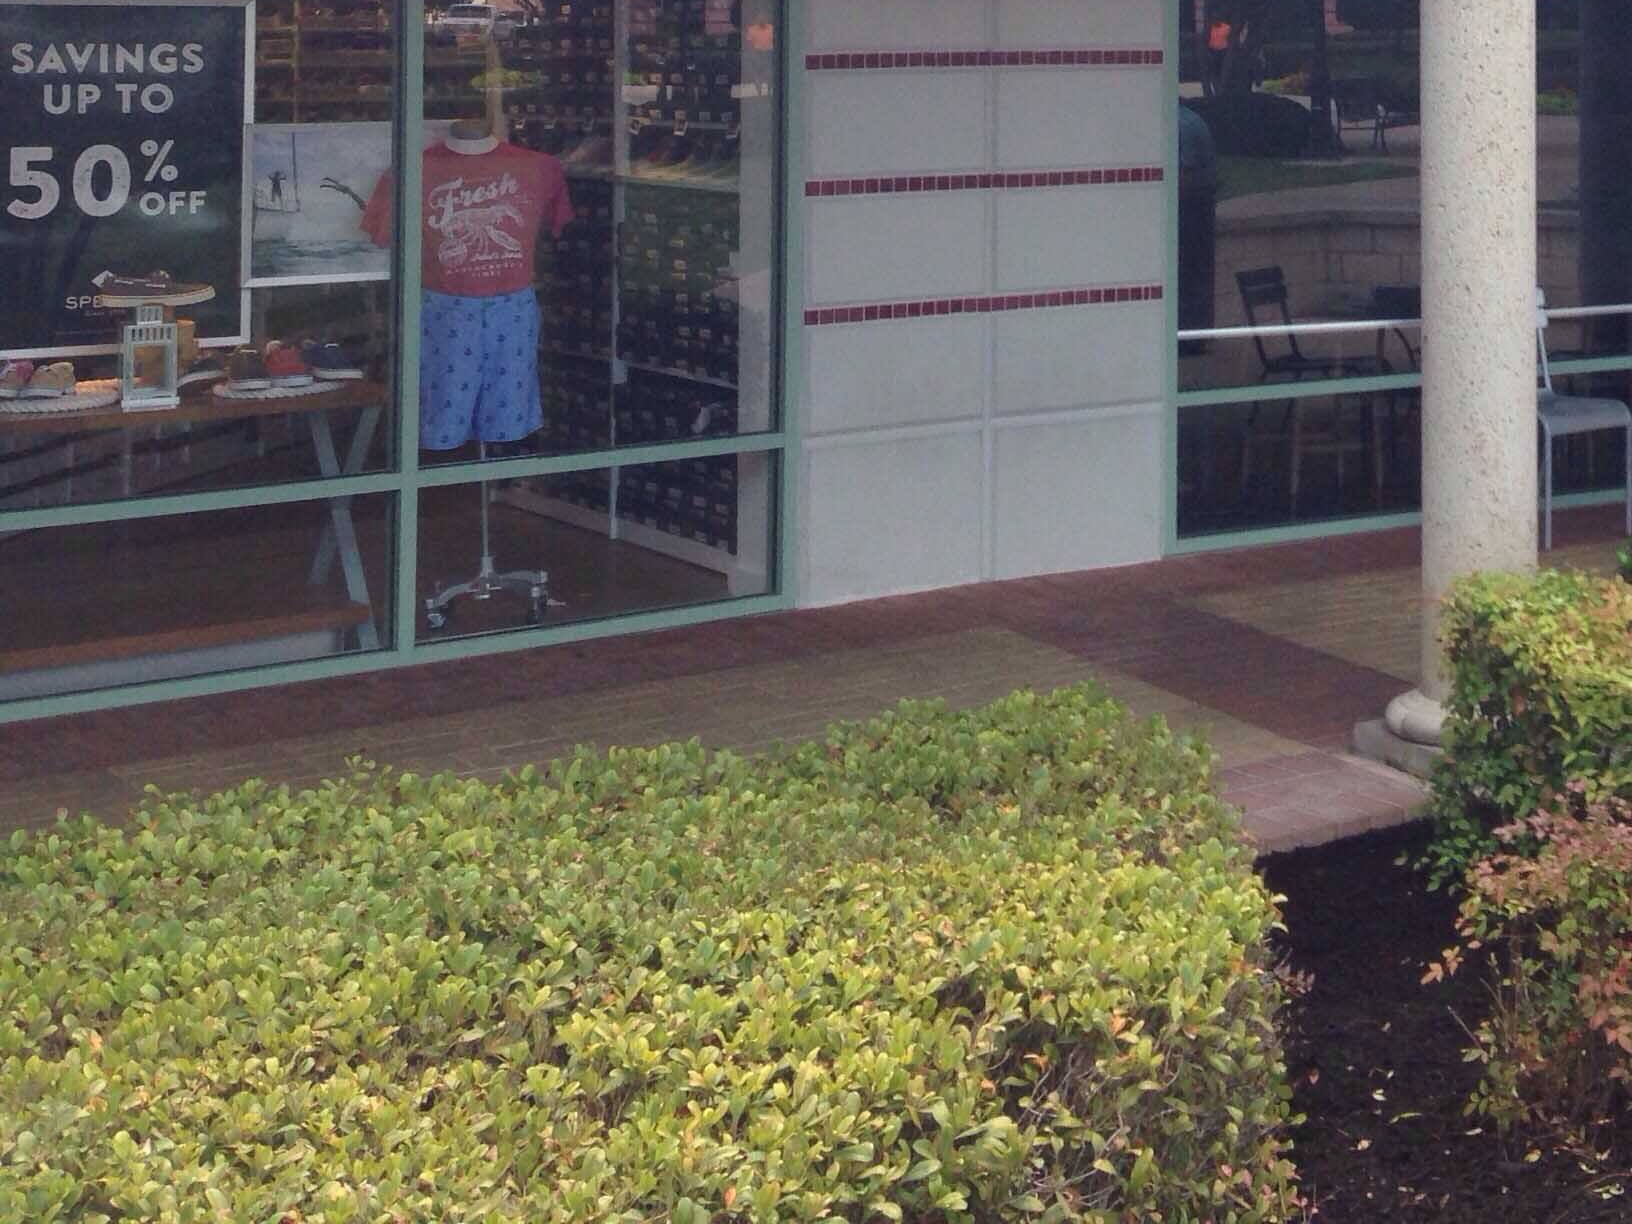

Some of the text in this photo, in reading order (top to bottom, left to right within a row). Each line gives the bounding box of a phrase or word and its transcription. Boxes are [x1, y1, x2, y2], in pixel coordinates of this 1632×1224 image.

[11, 42, 204, 74] SAVINGS
[43, 83, 174, 115] UP TO
[139, 191, 207, 216] OFF
[428, 173, 518, 229] Fresh
[65, 295, 104, 310] SPE
